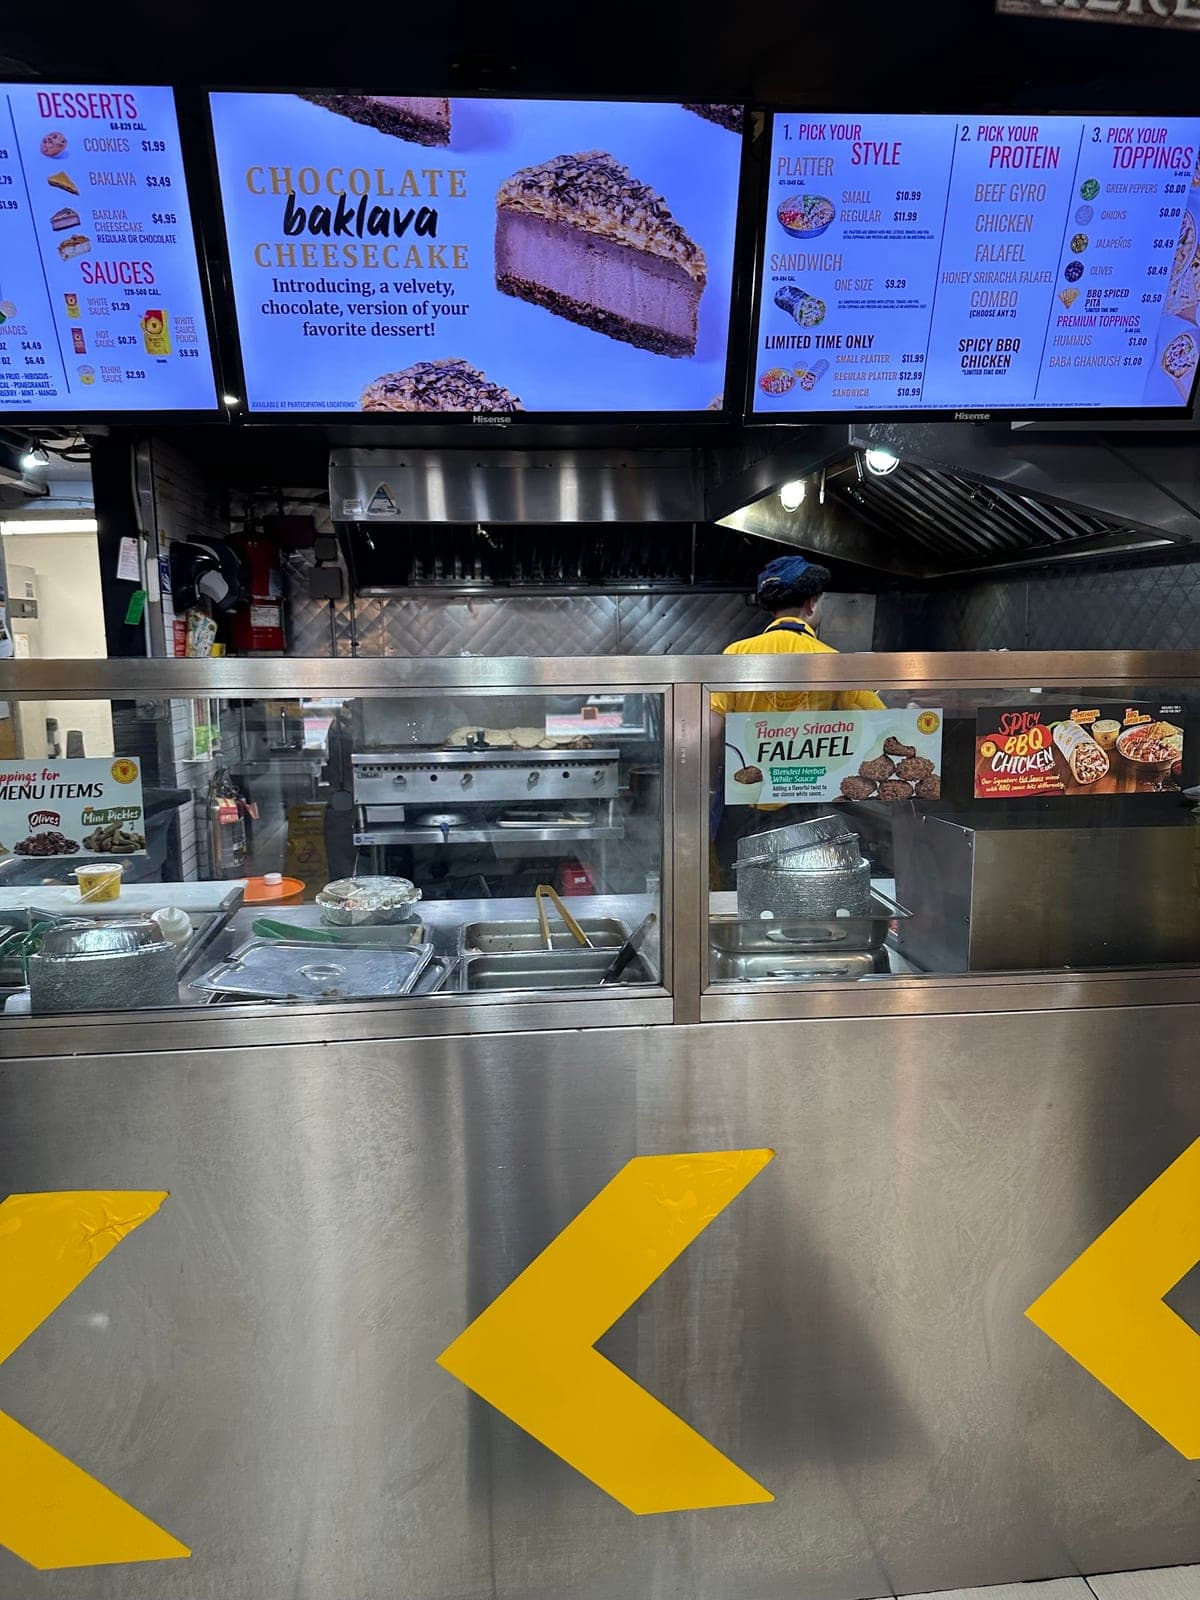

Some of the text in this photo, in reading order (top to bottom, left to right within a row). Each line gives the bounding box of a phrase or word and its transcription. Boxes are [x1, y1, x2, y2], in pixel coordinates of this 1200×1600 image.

[37, 92, 137, 119] DESSERTS
[784, 124, 862, 141] 1. PICK YOUR
[960, 125, 1039, 143] 2. PICK YOUR
[1092, 127, 1168, 144] 3. PICK YOUR
[83, 138, 166, 152] COOKIES $1.99
[851, 142, 902, 165] STYLE
[989, 145, 1060, 168] PROTEIN
[1112, 146, 1193, 169] TOPPINGS
[777, 157, 834, 177] PLATTER
[0, 175, 13, 185] .79
[88, 171, 171, 187] BAKLAVA $3.49
[246, 166, 468, 198] CHOCOLATE
[974, 184, 1047, 202] BEEF GYRO
[1105, 183, 1186, 194] GREEN PEPPERS $0.00
[841, 191, 922, 204] SMALL $10.99
[92, 210, 177, 225] BAKLAVA $4.95
[283, 190, 439, 239] baklava
[840, 210, 918, 223] REGULAR $11.99
[1101, 208, 1181, 220] ONIONS $0.00
[94, 221, 144, 233] CHEESECAKE
[975, 214, 1034, 233] CHICKEN
[97, 234, 177, 244] REGULAR OR CHOCOLATE
[1153, 239, 1175, 249] $0.49
[254, 243, 470, 269] CHEESECAKE
[974, 244, 1025, 263] FALAFEL
[770, 254, 843, 272] SANDWICH
[80, 261, 155, 285] SAUCES
[942, 271, 1054, 284] HONEY SRIRACHA FALAFEL
[1090, 266, 1168, 276] OLIVES $0.49
[272, 278, 455, 297] Introducing, a velvety,
[834, 279, 906, 291] ONE SIZE $9.29
[970, 290, 1018, 308] COMBO
[1086, 288, 1162, 303] BBQ SPICED $0.50
[87, 298, 130, 311] WHITE $1.29
[1085, 299, 1101, 308] PITA
[88, 307, 110, 316] SAUCE
[261, 301, 469, 320] chocolate, version of your
[969, 310, 996, 318] (CHOOSE
[1010, 310, 1017, 318] 2)
[174, 317, 194, 325] WHITE
[1057, 315, 1141, 327] PREMIUM TOPPINGS
[175, 326, 196, 334] SAUCE
[303, 322, 436, 336] favorite dessert!
[21, 341, 42, 350] $4.49
[95, 336, 137, 348] SAUCE $0.75
[176, 335, 198, 343] POUCH
[765, 335, 875, 349] LIMITED TIME ONLY
[1053, 335, 1148, 347] HUMMUS $1.00
[959, 339, 1021, 353] SPICY BBQ
[178, 349, 199, 357] $9.99
[835, 354, 925, 364] SMALL PLATTER $11.99
[2, 356, 45, 365] OZ $6.49
[960, 355, 1011, 368] CHICKEN
[1049, 356, 1143, 368] BABA GHANOUSH $1.00
[100, 366, 146, 379] TAHINI $2.99
[103, 375, 124, 383] SAUCE
[834, 371, 923, 381] REGULAR PLATTER $12.99
[832, 388, 921, 398] SANDWICH $10.99
[472, 415, 511, 424] Hisense
[954, 411, 991, 421] Hisense
[757, 720, 855, 740] Honey Sriracha
[998, 711, 1041, 736] SPICY
[1004, 727, 1044, 756] BBQ
[757, 735, 854, 763] FALAFEL
[991, 746, 1054, 775] CHICKEN
[0, 767, 60, 787] ppings for
[772, 768, 800, 776] Blended
[772, 775, 792, 783] White
[0, 783, 104, 800] MENU ITEMS
[30, 814, 59, 826] Olives
[83, 812, 105, 825] Mini
[107, 808, 139, 821] Pickles
